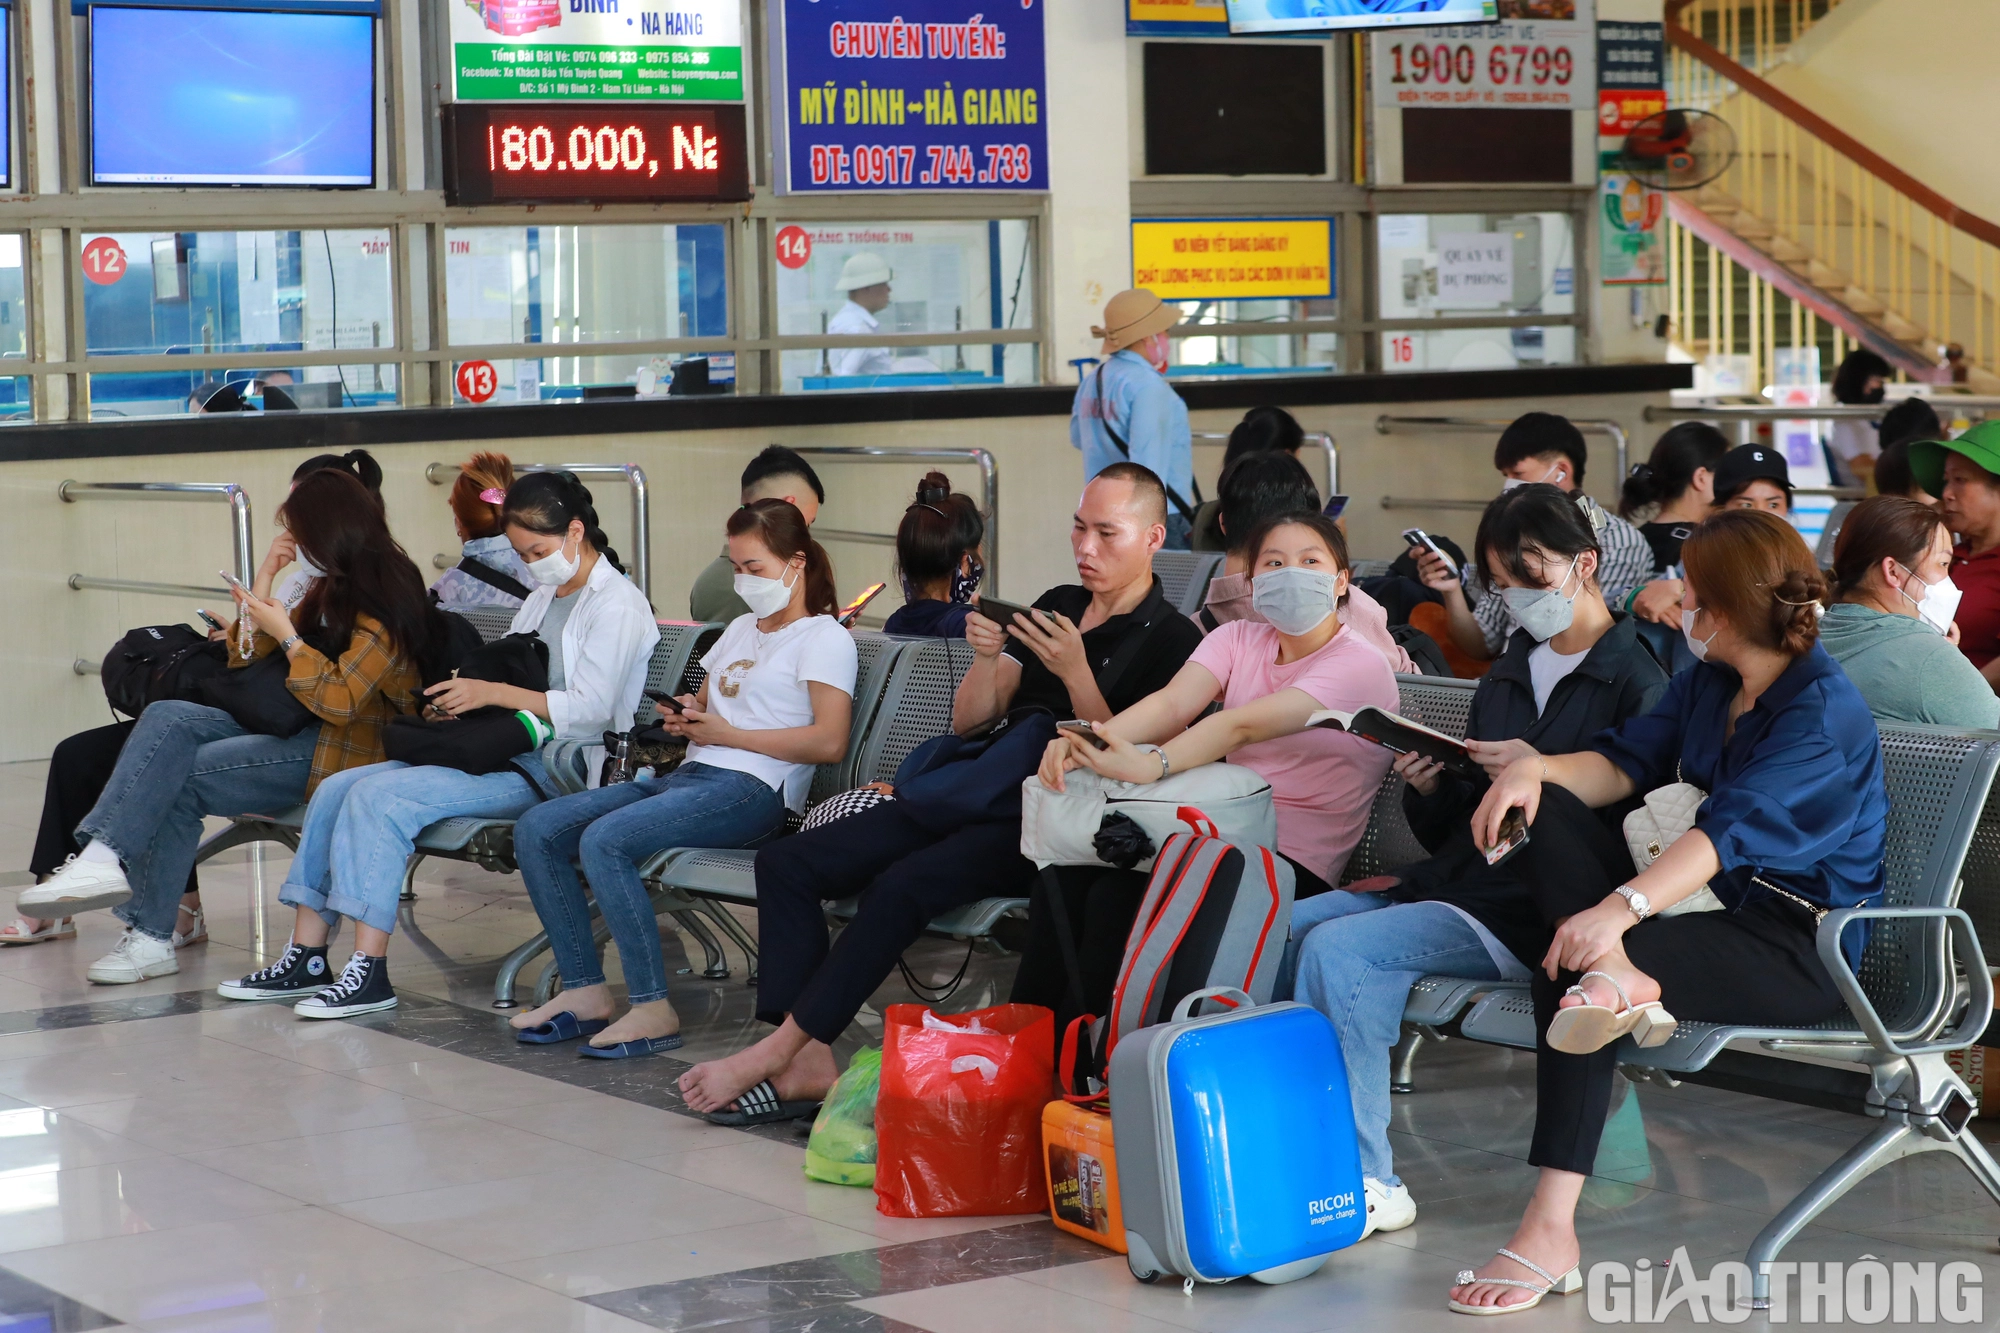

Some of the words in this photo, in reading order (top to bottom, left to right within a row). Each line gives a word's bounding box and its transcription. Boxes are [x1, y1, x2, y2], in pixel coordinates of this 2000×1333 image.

[641, 12, 661, 35] NA
[665, 12, 703, 35] HANG
[831, 15, 922, 58] CHUYÊN
[925, 14, 1006, 59] TUYẾN:
[573, 51, 597, 63] 0974
[646, 52, 670, 63] 0975
[672, 52, 690, 64] 854
[1390, 43, 1475, 84] 1900
[1488, 45, 1574, 85] 6799
[462, 67, 502, 77] Facebook:
[503, 67, 514, 77] Xe
[515, 67, 540, 78] Khách
[598, 68, 623, 79] Quang
[637, 69, 670, 79] Website:
[590, 83, 596, 94] 2
[602, 84, 621, 94] Nam
[800, 81, 838, 125] MỸ
[844, 81, 905, 125] ĐÌNH
[924, 81, 958, 125] HÀ
[963, 88, 1038, 125] GIANG
[810, 145, 850, 184] ĐT:
[853, 144, 915, 184] 0917
[450, 241, 470, 254] TIN
[780, 235, 807, 259] 14
[88, 247, 120, 273] 12
[1392, 337, 1413, 362] 16
[465, 366, 493, 396] 13
[1753, 451, 1764, 462] C
[1309, 1192, 1355, 1215] RICOH
[1310, 1214, 1335, 1225] imagine.
[1335, 1208, 1357, 1219] change.
